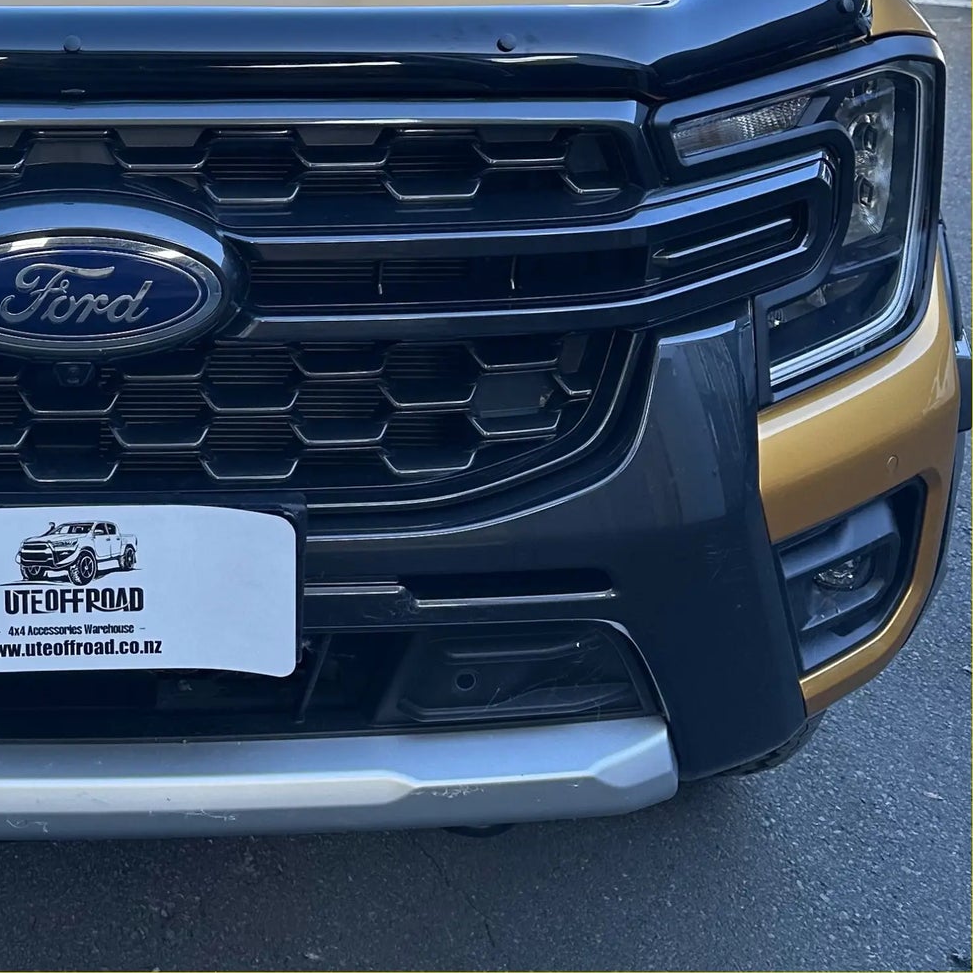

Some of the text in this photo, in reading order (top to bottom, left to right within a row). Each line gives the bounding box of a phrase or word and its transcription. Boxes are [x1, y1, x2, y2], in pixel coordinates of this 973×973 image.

[0, 263, 153, 323] Ford
[8, 623, 135, 637] 4x4 Accessories Warehouse
